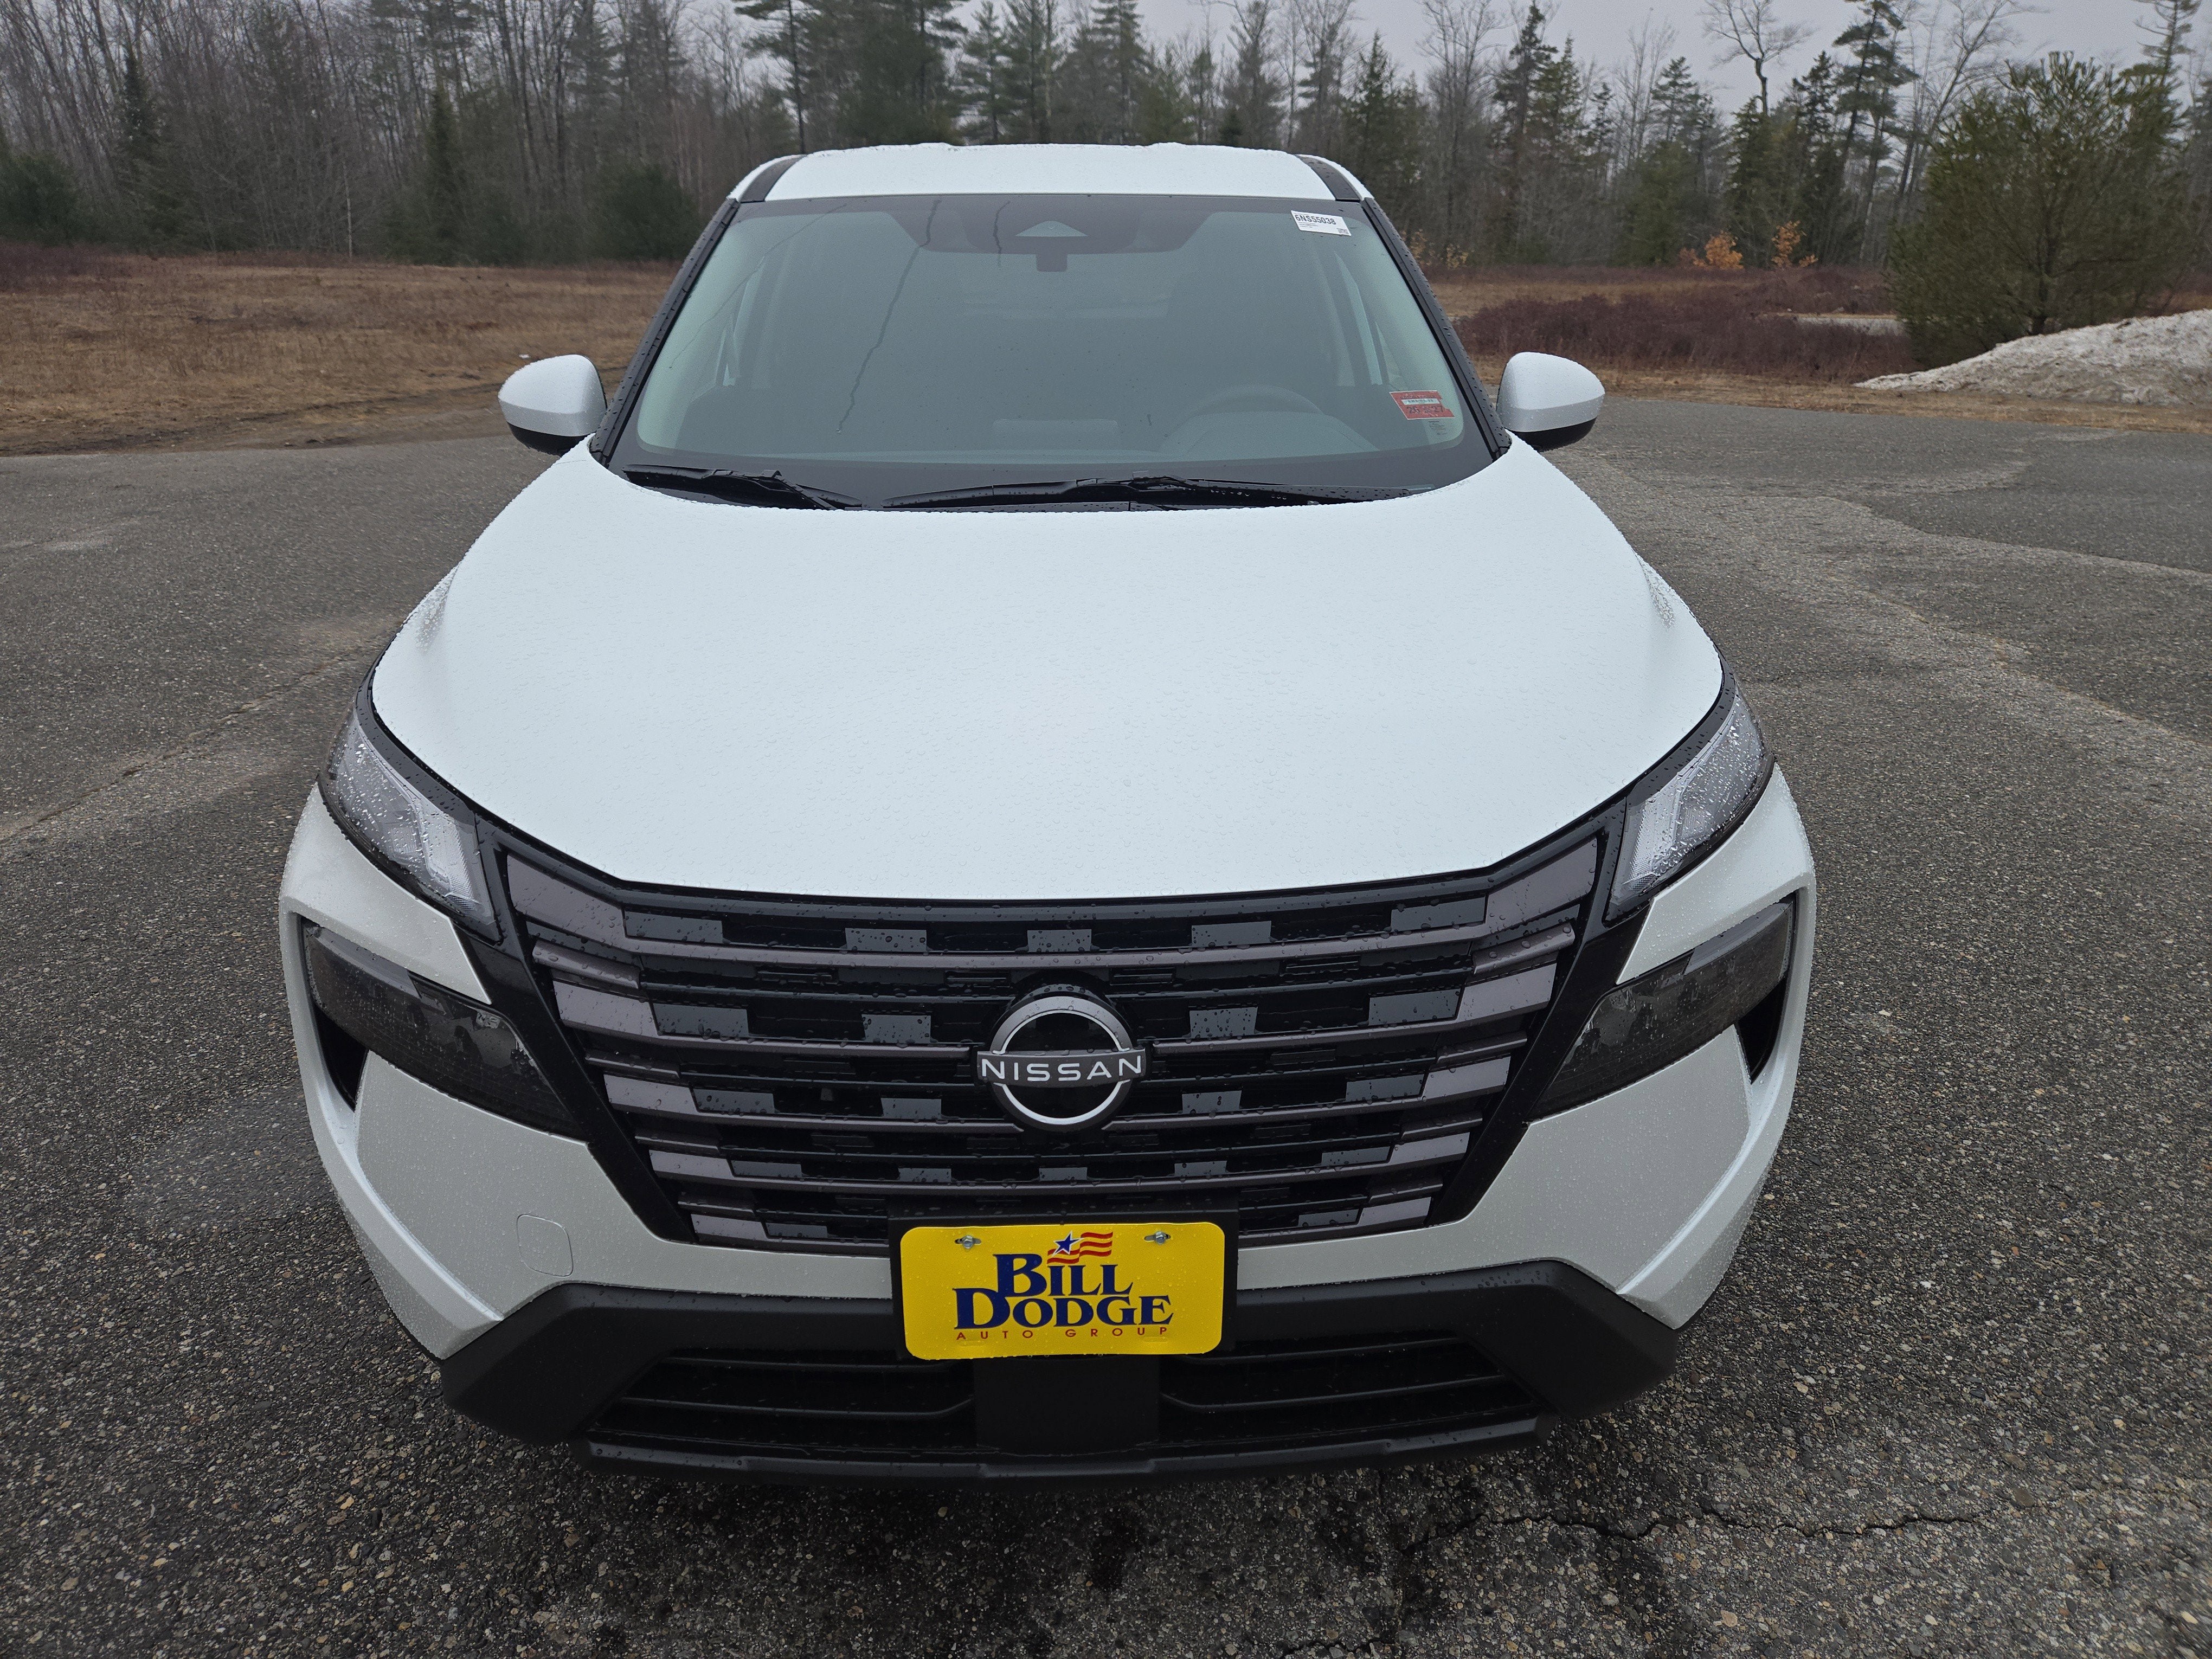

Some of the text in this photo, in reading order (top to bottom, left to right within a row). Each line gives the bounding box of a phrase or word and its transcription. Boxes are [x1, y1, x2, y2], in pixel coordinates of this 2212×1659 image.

[1294, 214, 1336, 225] 6NS55038
[981, 1055, 1141, 1082] NISSAN
[993, 1253, 1133, 1297] BILL
[952, 1288, 1174, 1330] DODGE
[956, 1326, 1168, 1341] AUTO GROUP
